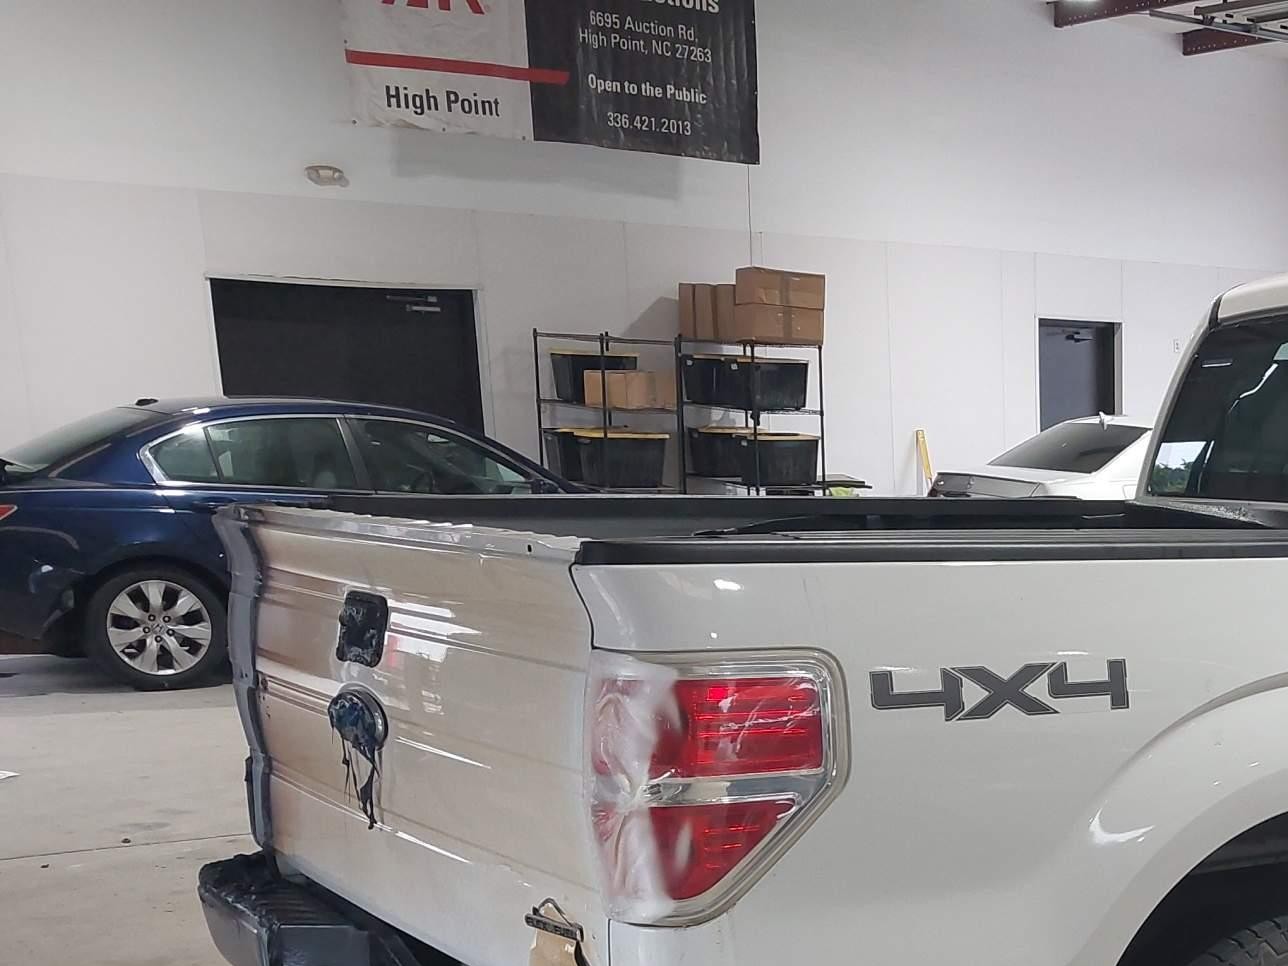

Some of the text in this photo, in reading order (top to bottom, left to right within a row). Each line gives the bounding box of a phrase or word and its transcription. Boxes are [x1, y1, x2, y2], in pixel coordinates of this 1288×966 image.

[589, 10, 620, 29] 6695
[624, 16, 675, 38] Auction
[579, 27, 712, 63] High Point, NC 27263
[385, 85, 500, 117] High Point
[587, 74, 707, 104] Open to the Public
[607, 112, 692, 136] 336.421.2013
